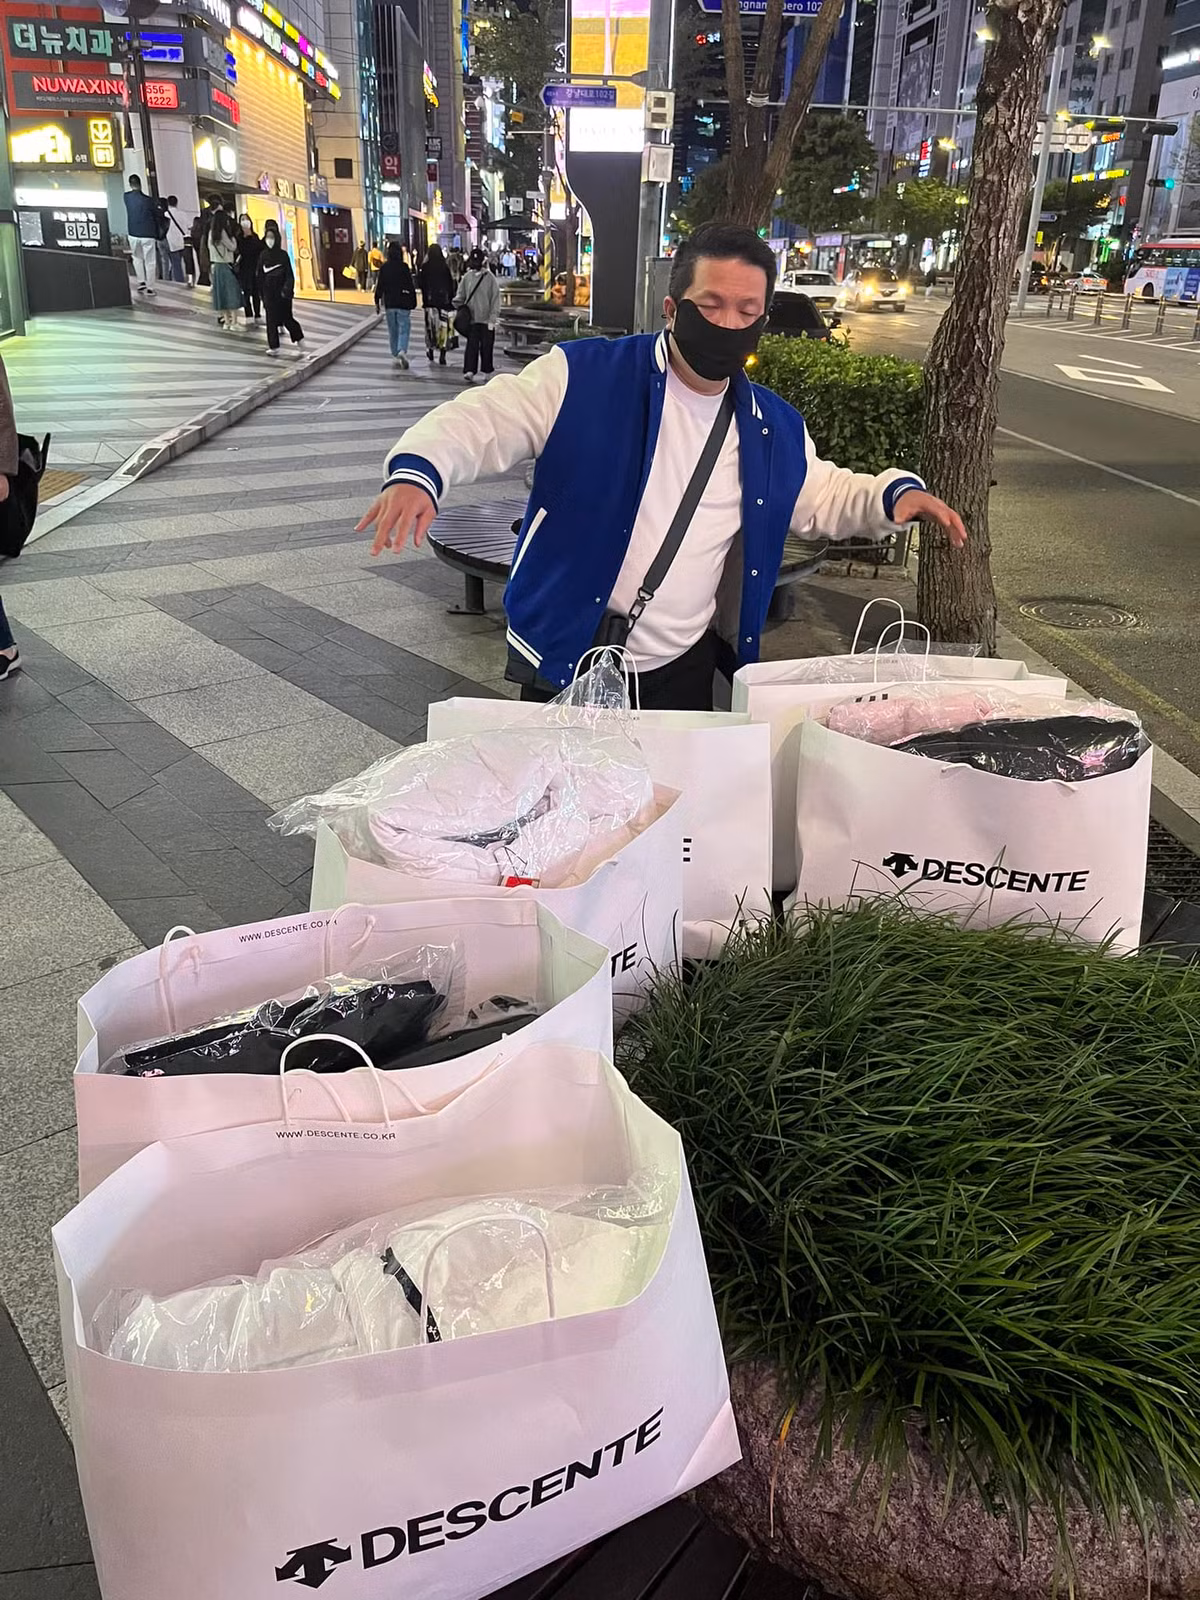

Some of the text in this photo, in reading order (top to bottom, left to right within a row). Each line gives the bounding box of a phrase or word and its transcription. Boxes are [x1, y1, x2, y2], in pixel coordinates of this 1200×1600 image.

[12, 23, 113, 57] 더뉴치과
[147, 96, 172, 106] 4222
[66, 224, 99, 237] 829
[921, 858, 1090, 893] DESCENTE
[275, 1129, 396, 1141] WWW.DESCENTE.CO.KR
[360, 1406, 664, 1570] DESCENTE
